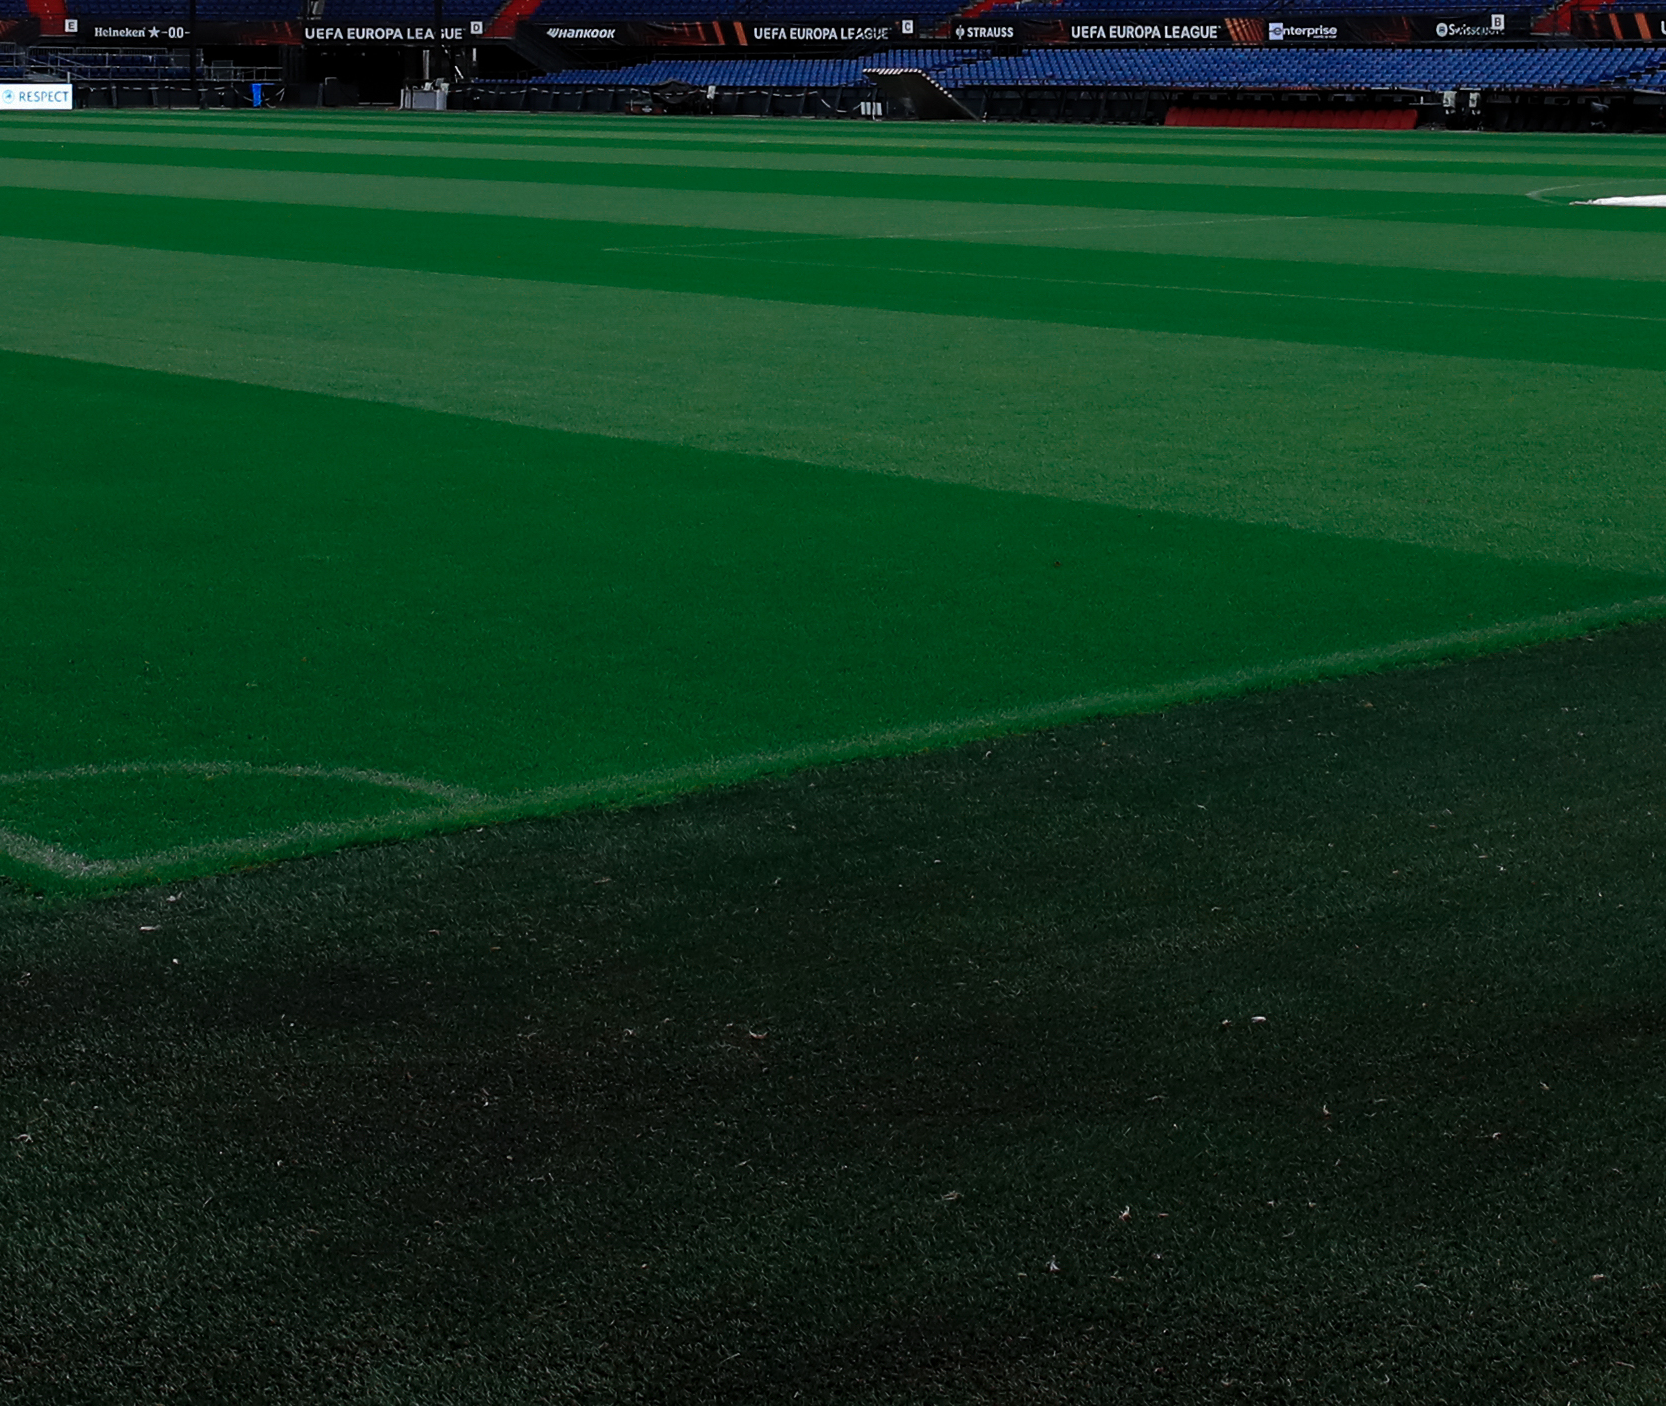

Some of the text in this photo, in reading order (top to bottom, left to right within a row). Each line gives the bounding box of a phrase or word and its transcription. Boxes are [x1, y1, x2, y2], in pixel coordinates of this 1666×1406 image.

[94, 26, 145, 38] Heineken
[304, 26, 344, 39] UEFA
[347, 27, 403, 39] EUROPA
[753, 27, 787, 40] UEFA
[790, 27, 838, 40] EUROPA
[966, 26, 1014, 37] STRAUSS
[1071, 25, 1218, 38] UEFA EUROPA LEAGUE
[1273, 24, 1338, 38] enterprise
[19, 90, 69, 102] RESPECT
